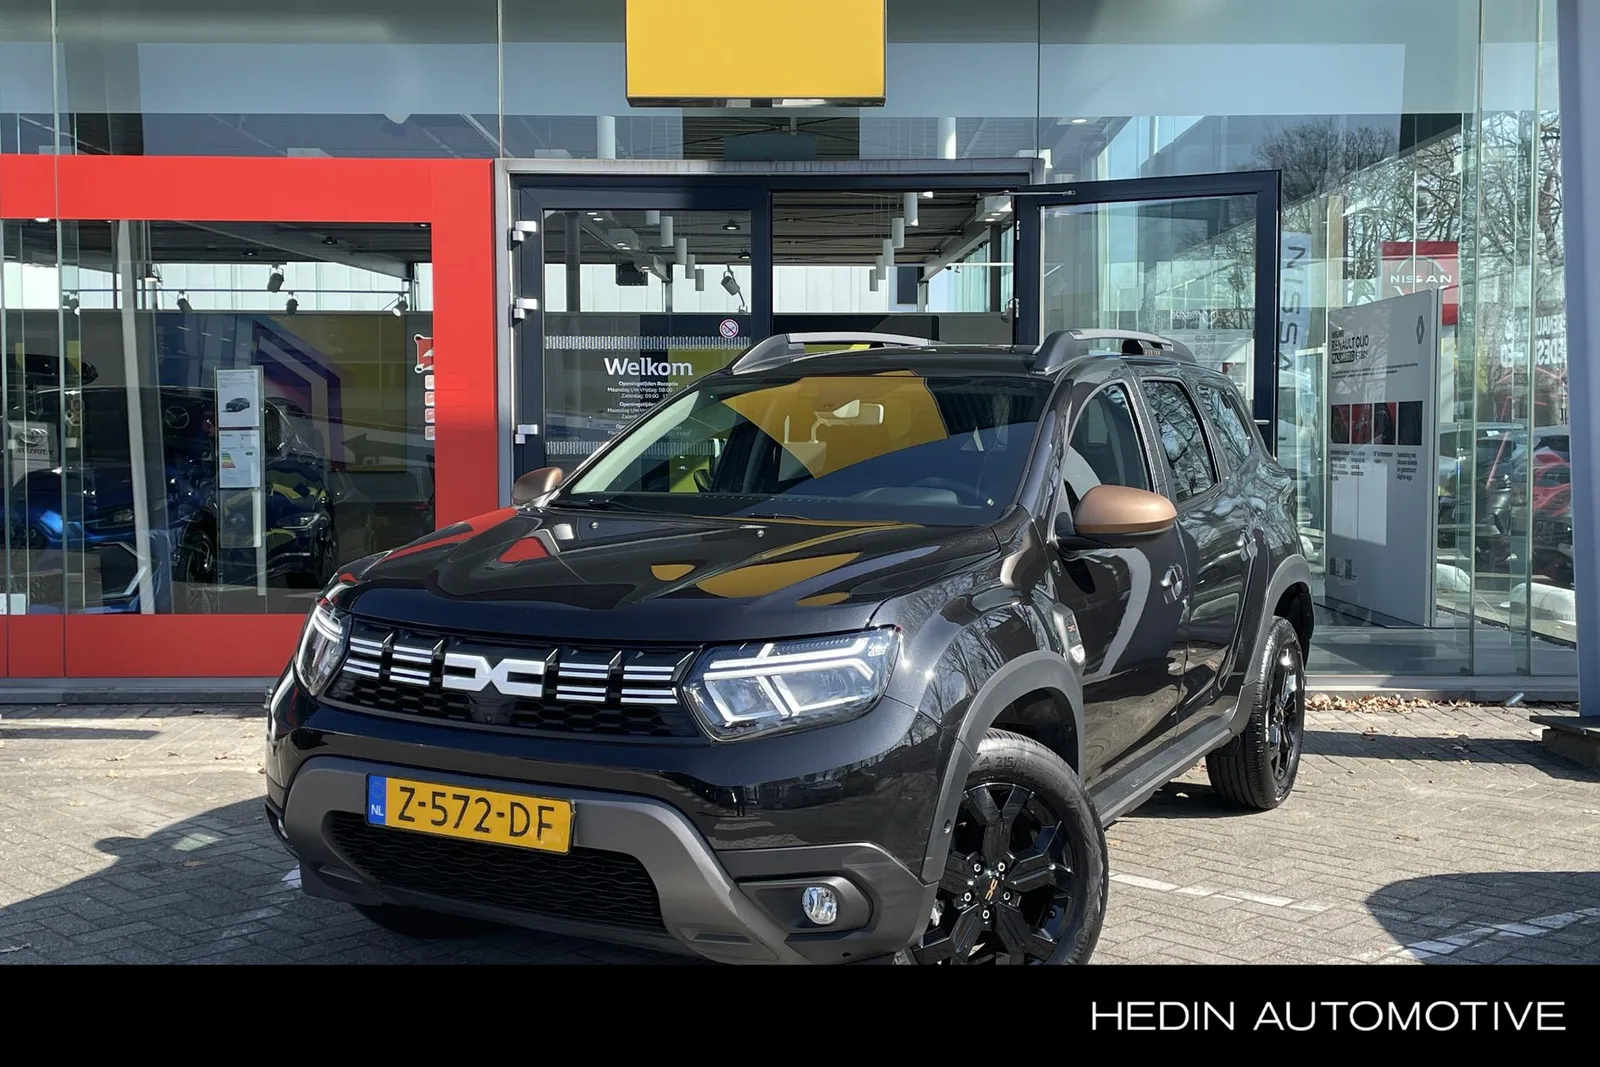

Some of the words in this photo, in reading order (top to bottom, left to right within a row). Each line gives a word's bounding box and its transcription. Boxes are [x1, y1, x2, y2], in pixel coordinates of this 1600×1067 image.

[1390, 274, 1452, 284] NISSAN
[603, 357, 693, 376] Welkom
[371, 804, 384, 817] NL
[398, 786, 555, 841] Z-572-DF
